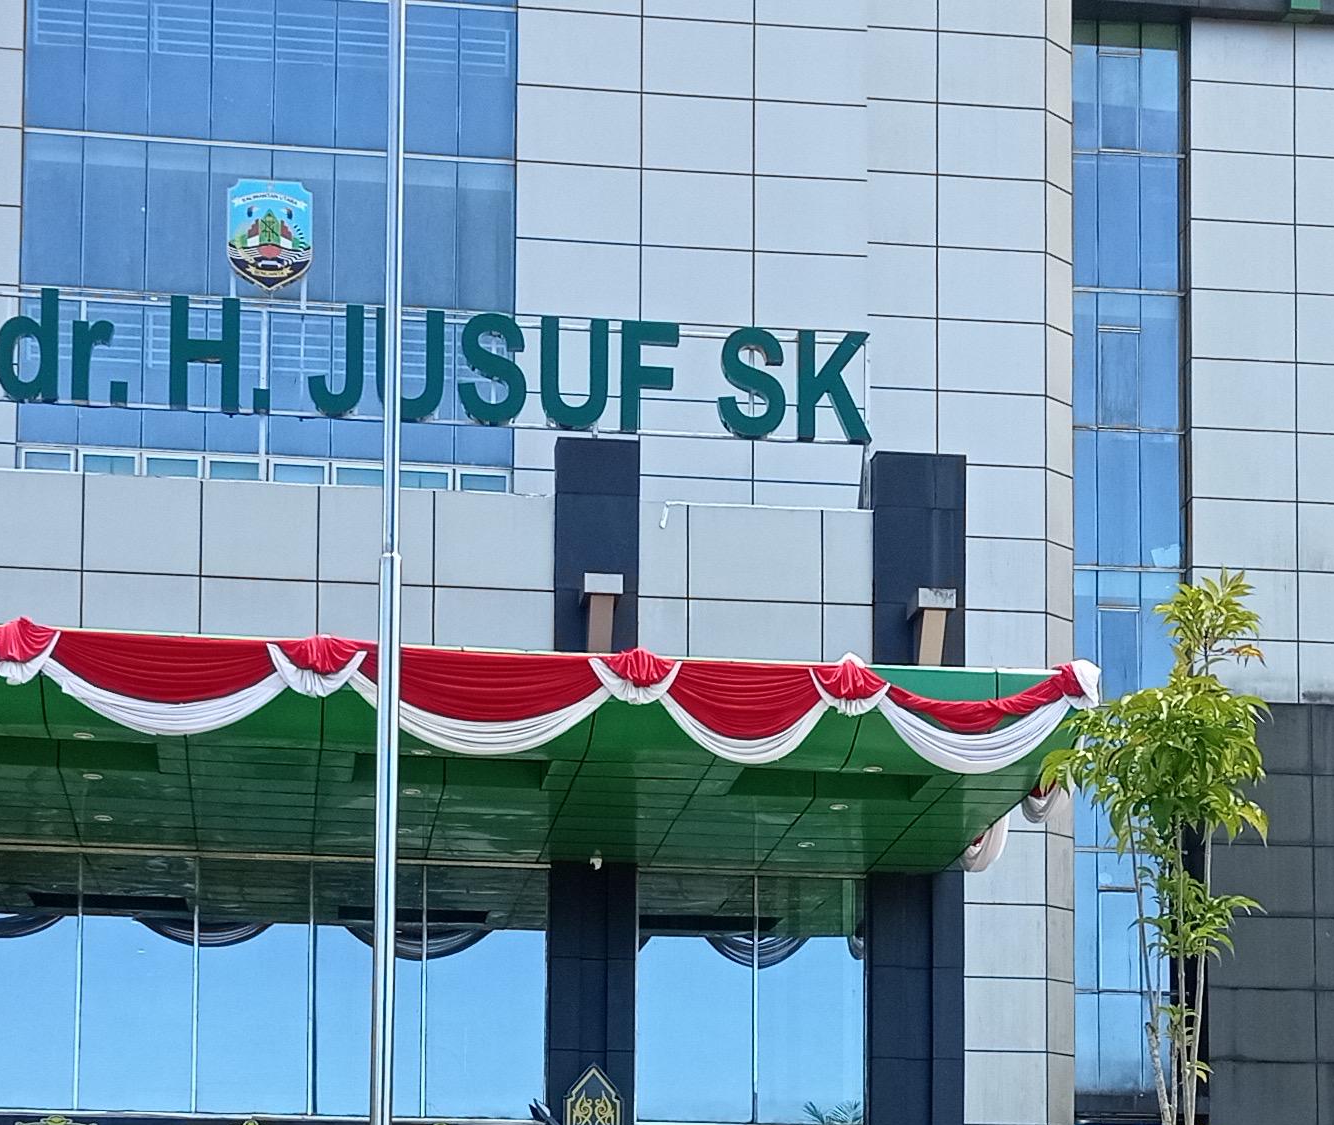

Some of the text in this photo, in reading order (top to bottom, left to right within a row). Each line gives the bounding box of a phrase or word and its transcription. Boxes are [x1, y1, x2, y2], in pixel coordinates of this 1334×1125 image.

[169, 294, 270, 414] H.
[307, 303, 680, 434] JUSUF
[717, 325, 873, 445] SK
